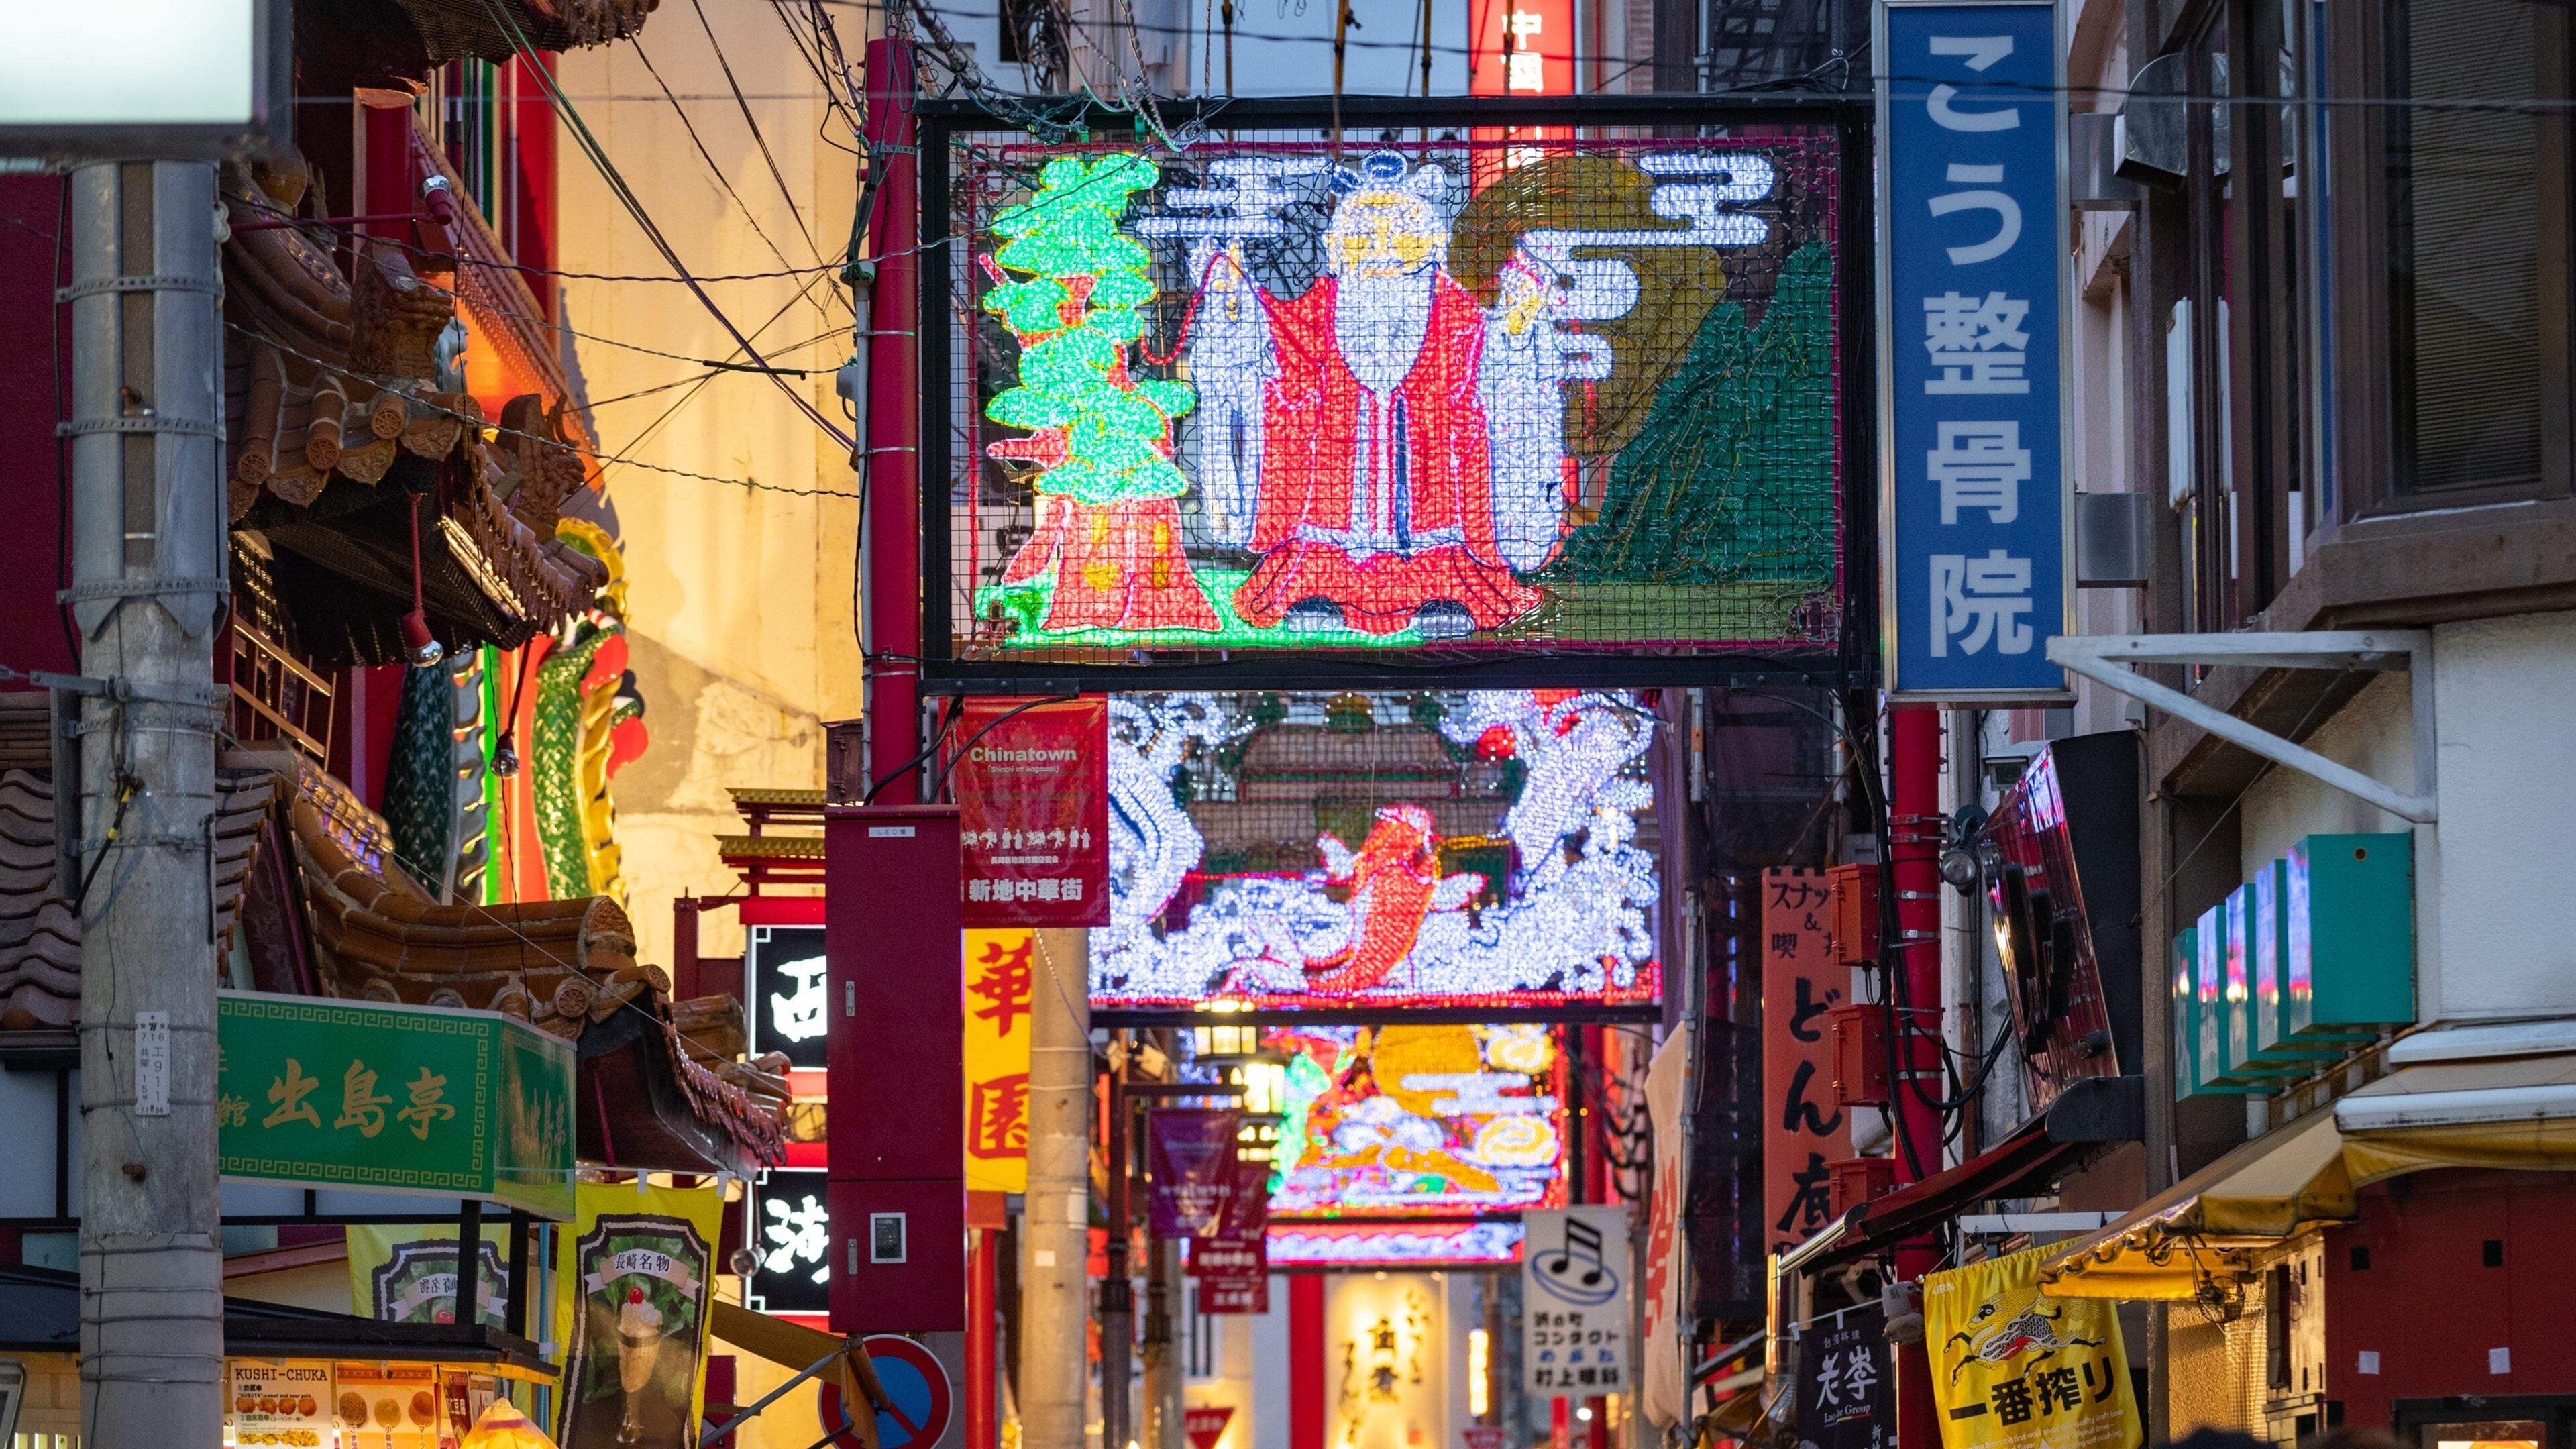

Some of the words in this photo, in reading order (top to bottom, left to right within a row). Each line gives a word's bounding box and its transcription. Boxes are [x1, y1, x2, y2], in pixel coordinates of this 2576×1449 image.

[1924, 36, 2033, 659] こう整骨院
[970, 747, 1077, 763] Chinatown
[969, 877, 1083, 902] 新地中華街
[1804, 912, 1822, 932] &
[1771, 931, 1832, 959] 喫
[262, 1058, 456, 1140] 出島亭
[614, 1252, 670, 1273] 長崎名物
[1534, 1330, 1619, 1346] コンタクト
[235, 1368, 328, 1381] KUSHI-CHUKA
[1845, 1404, 1871, 1415] Group
[2074, 1417, 2094, 1428] quality
[2095, 1412, 2110, 1421] draft
[2110, 1409, 2124, 1417] beer
[2086, 1436, 2097, 1445] and
